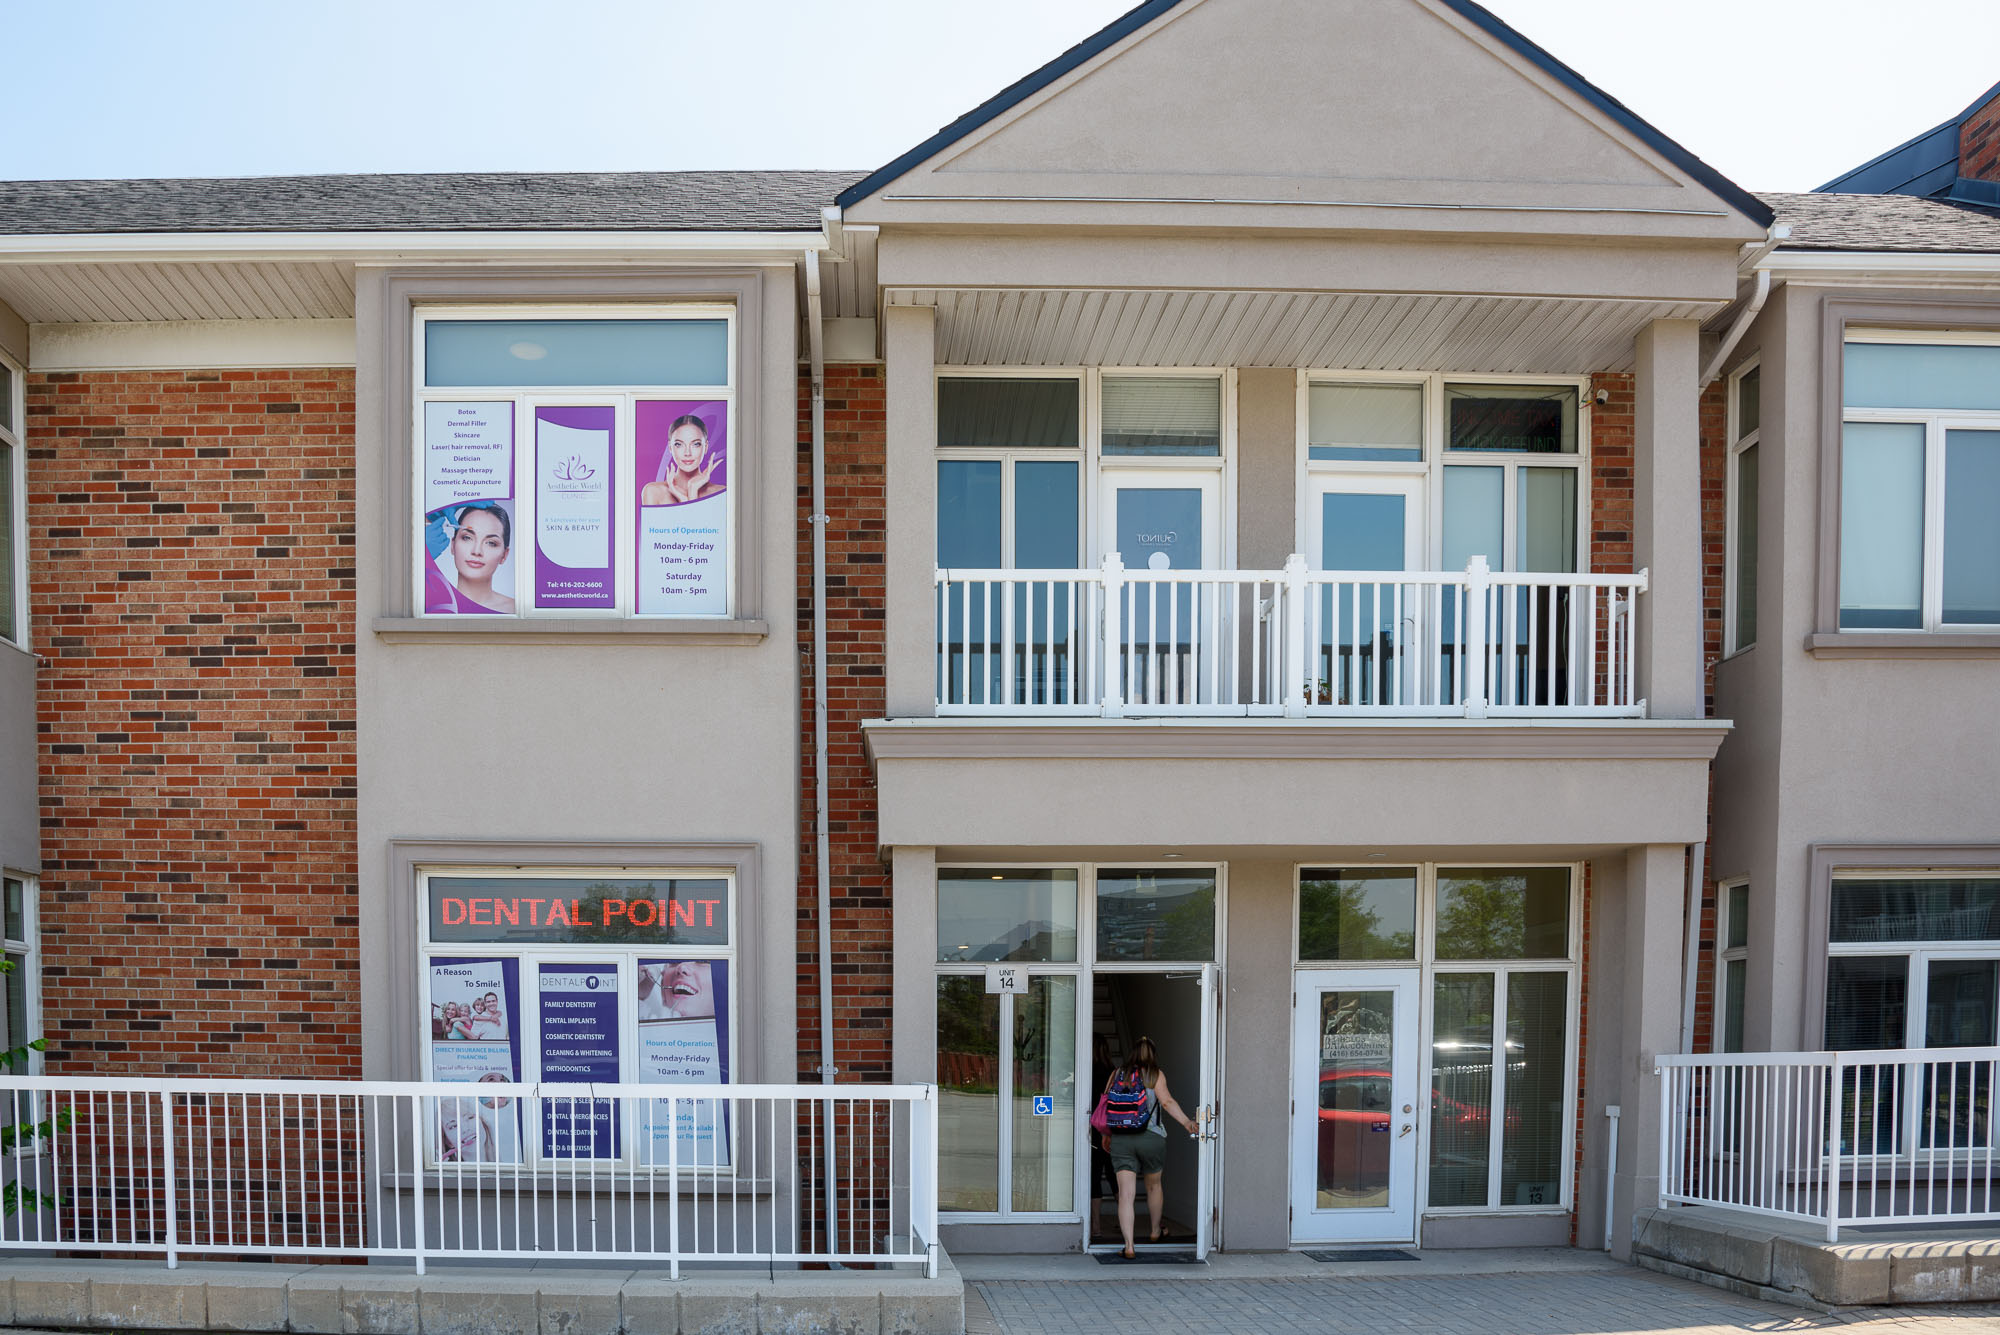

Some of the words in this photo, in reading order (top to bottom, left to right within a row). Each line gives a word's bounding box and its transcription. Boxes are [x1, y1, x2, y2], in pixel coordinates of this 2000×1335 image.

[1528, 409, 1555, 427] TAX
[1502, 436, 1556, 452] REFUND
[654, 542, 714, 551] Monday-Friday
[666, 573, 702, 581] Saturday
[689, 587, 707, 595] 5pm
[442, 898, 593, 926] DENTAL
[603, 899, 721, 927] POINT
[1000, 978, 1014, 988] 14
[651, 1055, 710, 1064] Monday-Friday
[1530, 1193, 1542, 1204] 13
